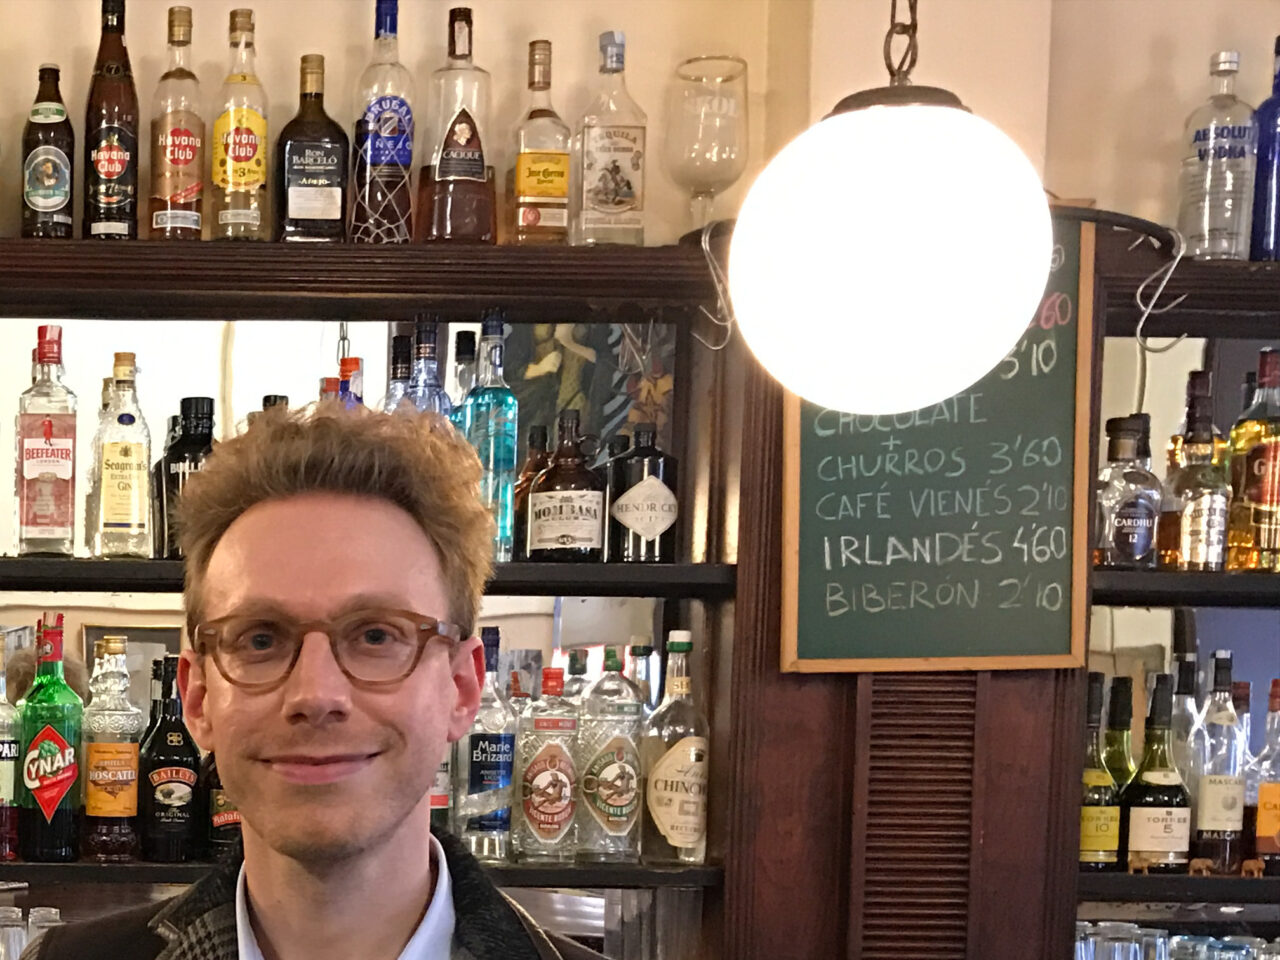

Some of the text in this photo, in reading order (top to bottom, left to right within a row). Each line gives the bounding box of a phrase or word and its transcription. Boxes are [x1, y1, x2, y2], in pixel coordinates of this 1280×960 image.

[365, 98, 411, 122] BRUGAL
[158, 134, 201, 147] Havana
[365, 138, 412, 150] ÑEJO
[91, 150, 130, 161] Havana
[166, 146, 193, 160] Club
[228, 144, 254, 157] Club
[442, 151, 481, 160] CACIQUE
[292, 154, 338, 165] BARCELÓ
[98, 161, 122, 172] Club
[1028, 292, 1072, 330] 60
[25, 447, 72, 461] BEEFEATER
[104, 459, 148, 473] Seagrm's
[170, 461, 206, 474] BULL
[817, 447, 966, 481] CHURROS
[815, 481, 891, 520] CAFÉ
[909, 479, 1012, 519] VIENÉS
[534, 504, 598, 520] MOMBASA
[1114, 518, 1153, 527] CARDHU
[1129, 533, 1138, 543] 12
[824, 521, 1003, 570] IRLANDÉS
[477, 740, 511, 751] Marie
[472, 750, 513, 762] Brizard
[23, 747, 75, 789] CYNAR
[152, 769, 195, 783] BAILEYS
[1096, 823, 1109, 832] 10
[1163, 823, 1174, 834] 5
[1202, 831, 1240, 840] MASCAR
